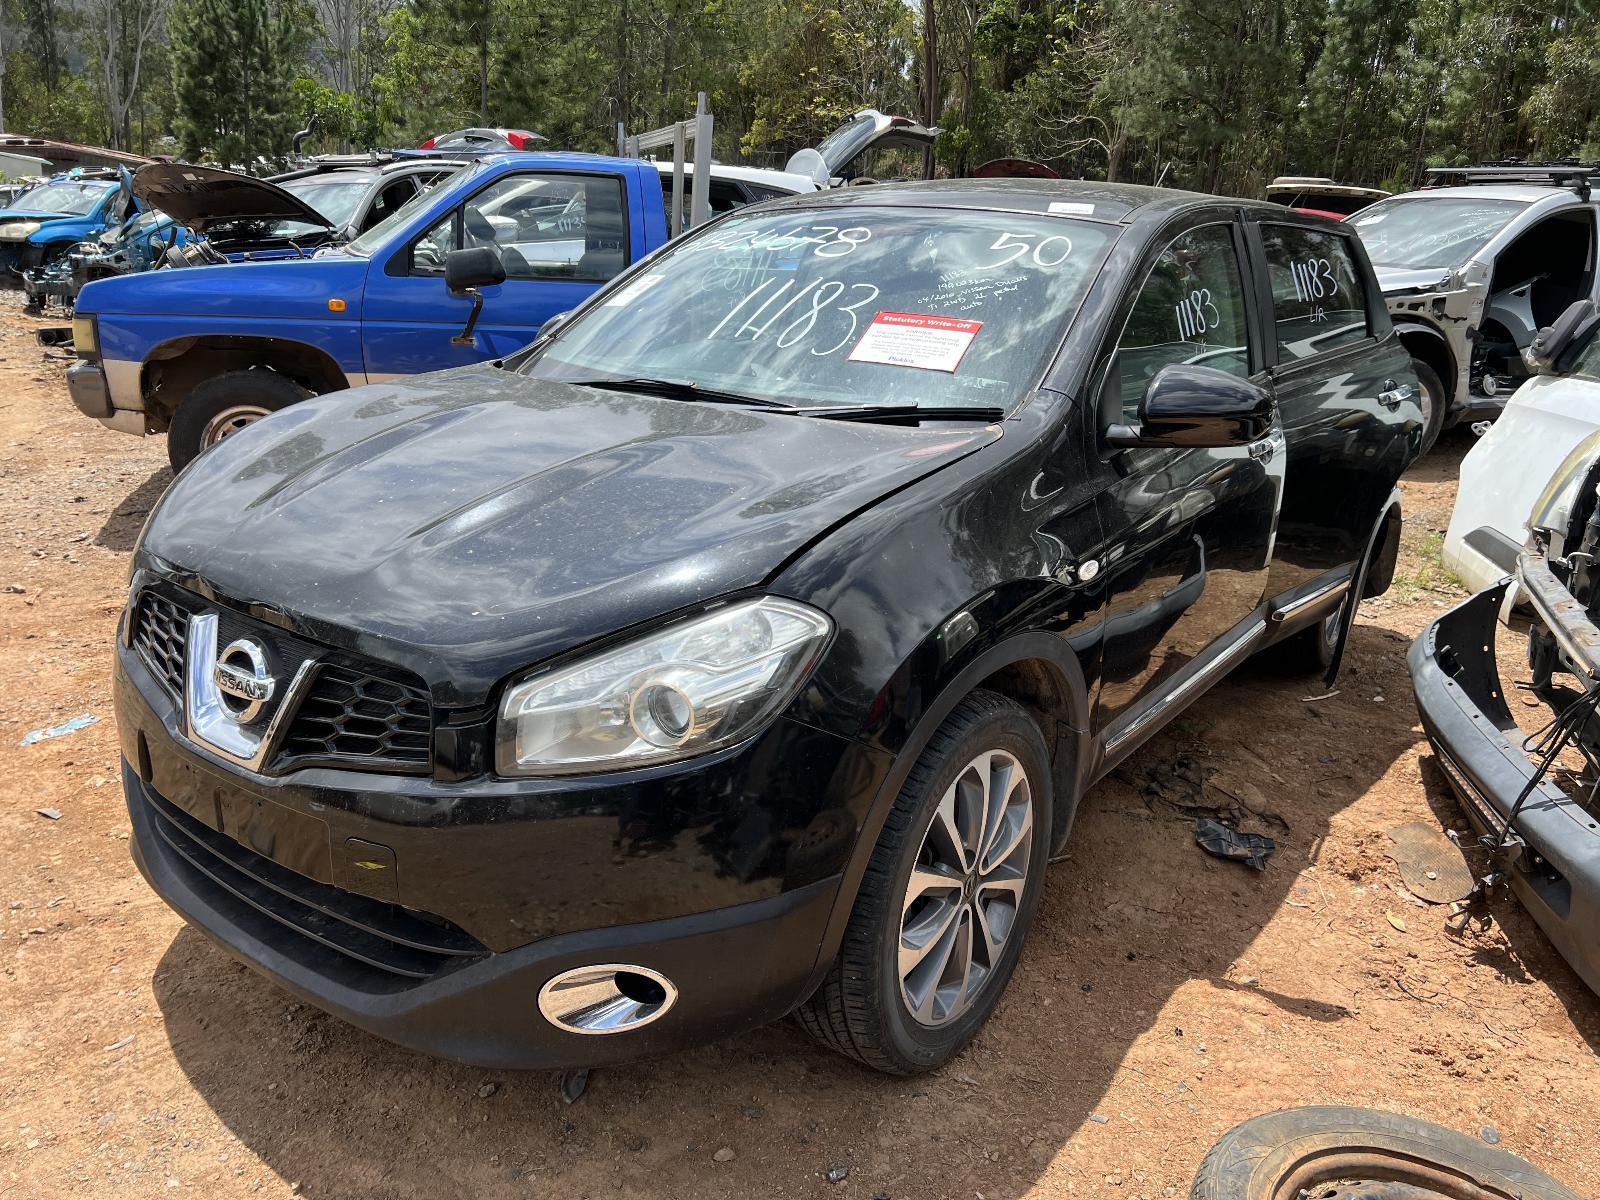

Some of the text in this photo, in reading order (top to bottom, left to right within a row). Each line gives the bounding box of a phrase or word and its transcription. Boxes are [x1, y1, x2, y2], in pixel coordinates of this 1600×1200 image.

[975, 232, 1072, 270] 50
[1291, 258, 1339, 303] 11183
[708, 276, 880, 356] 11183
[882, 315, 973, 330] Statutory Write-Off
[960, 301, 983, 311] auto
[1175, 288, 1220, 342] 11183
[215, 671, 259, 699] NISSAN
